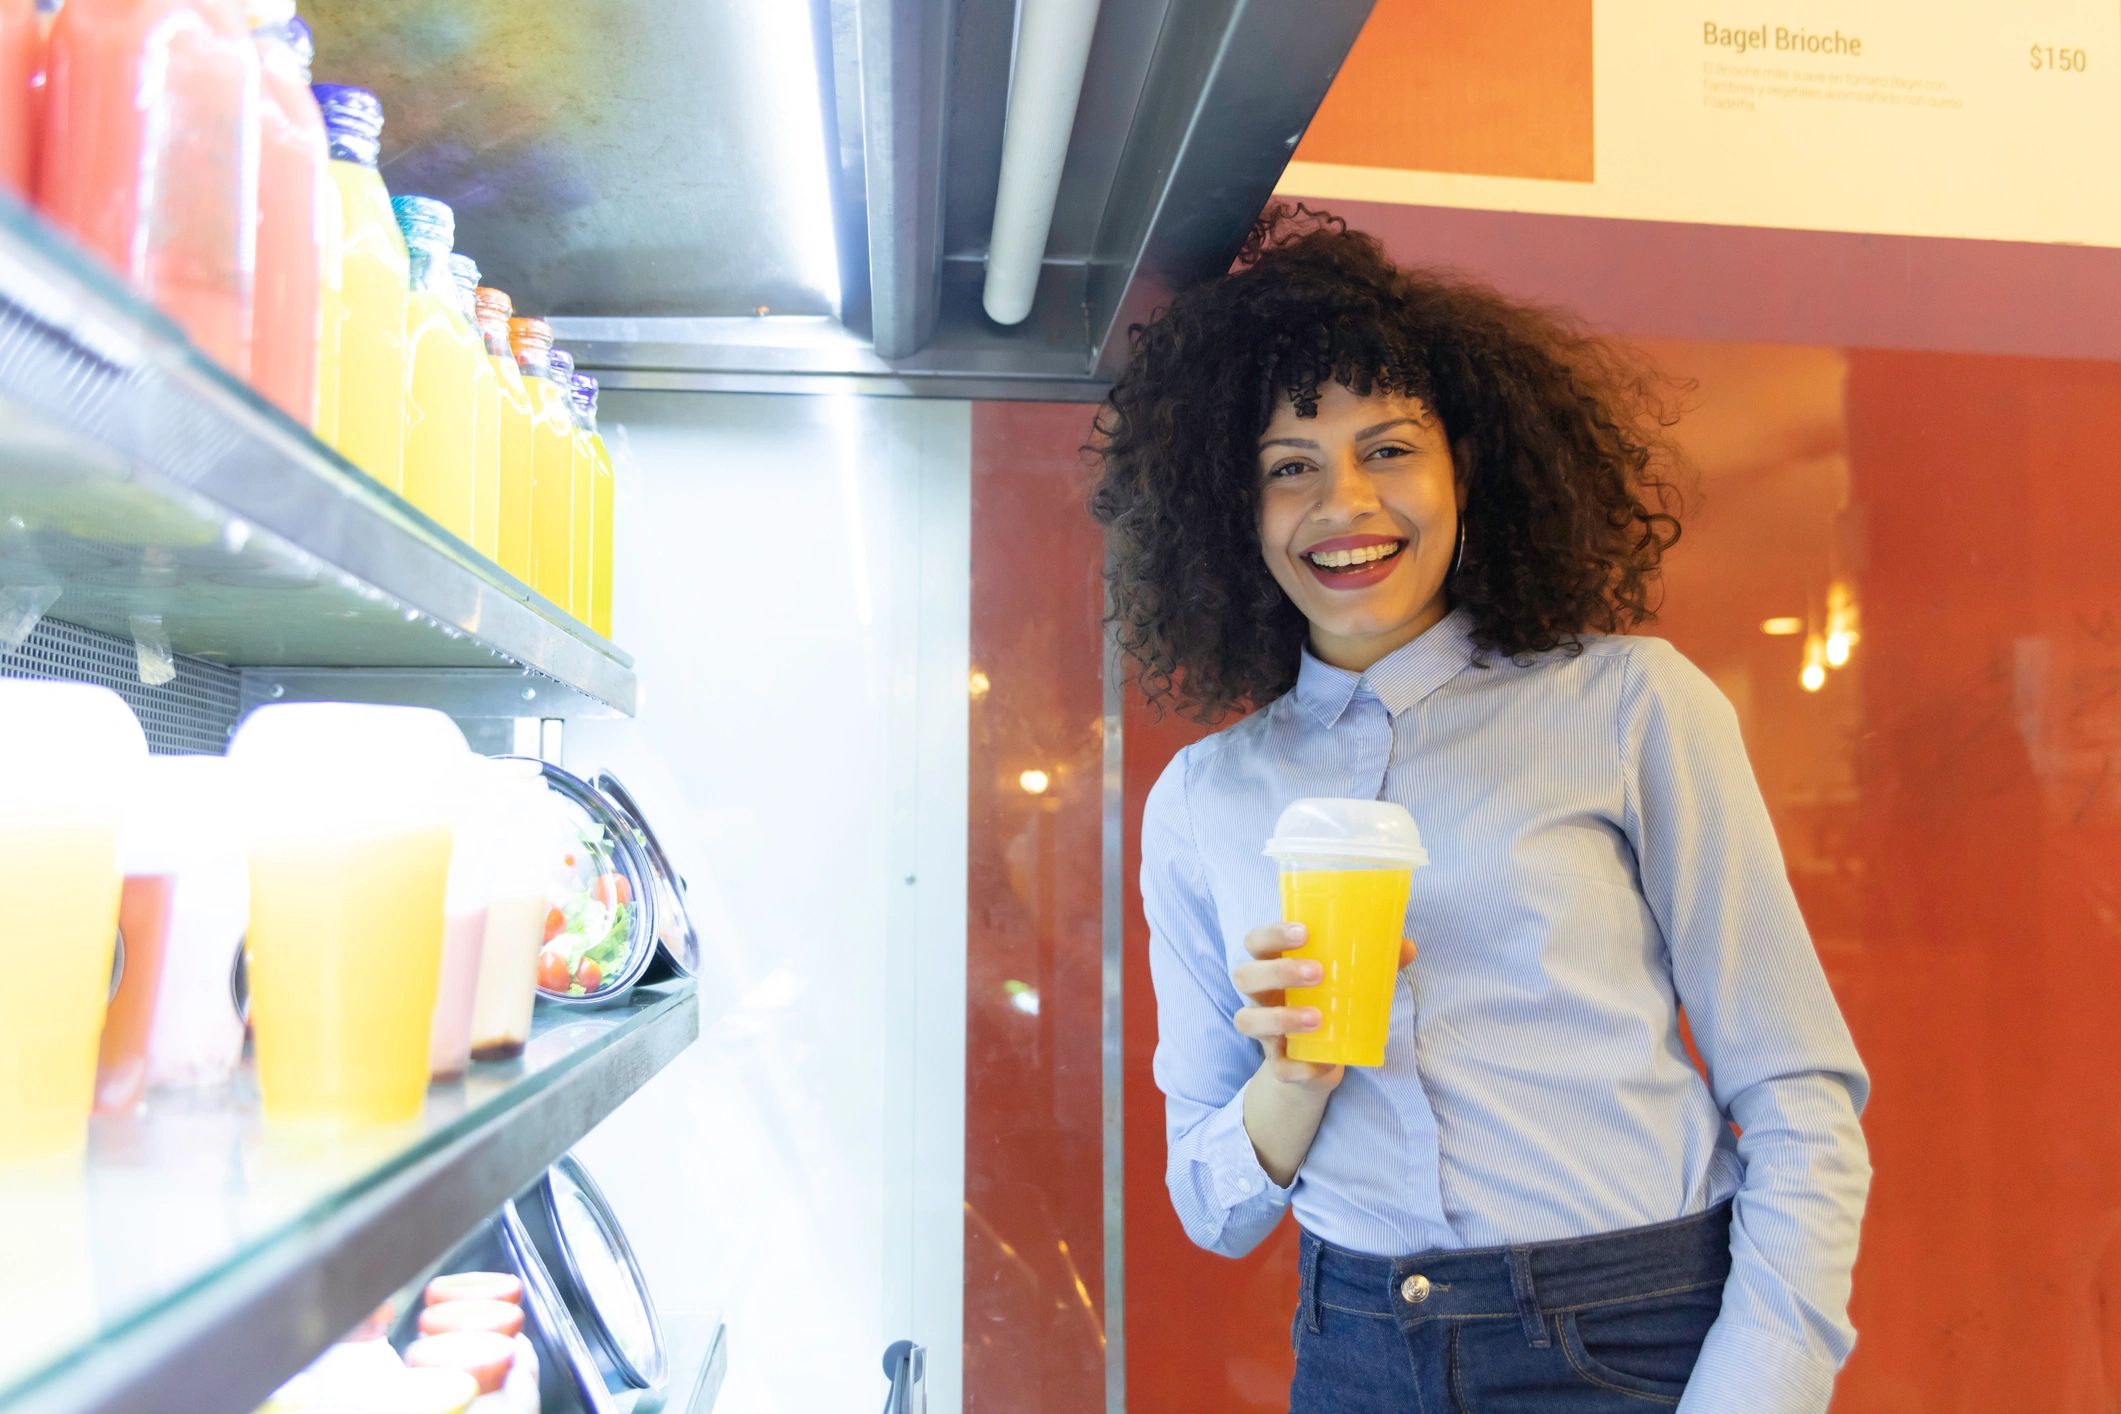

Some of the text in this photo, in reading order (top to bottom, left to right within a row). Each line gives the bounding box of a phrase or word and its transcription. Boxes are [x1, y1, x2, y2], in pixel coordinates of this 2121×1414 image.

[1702, 22, 1862, 56] Bagel Brioche
[2030, 43, 2087, 73] $150
